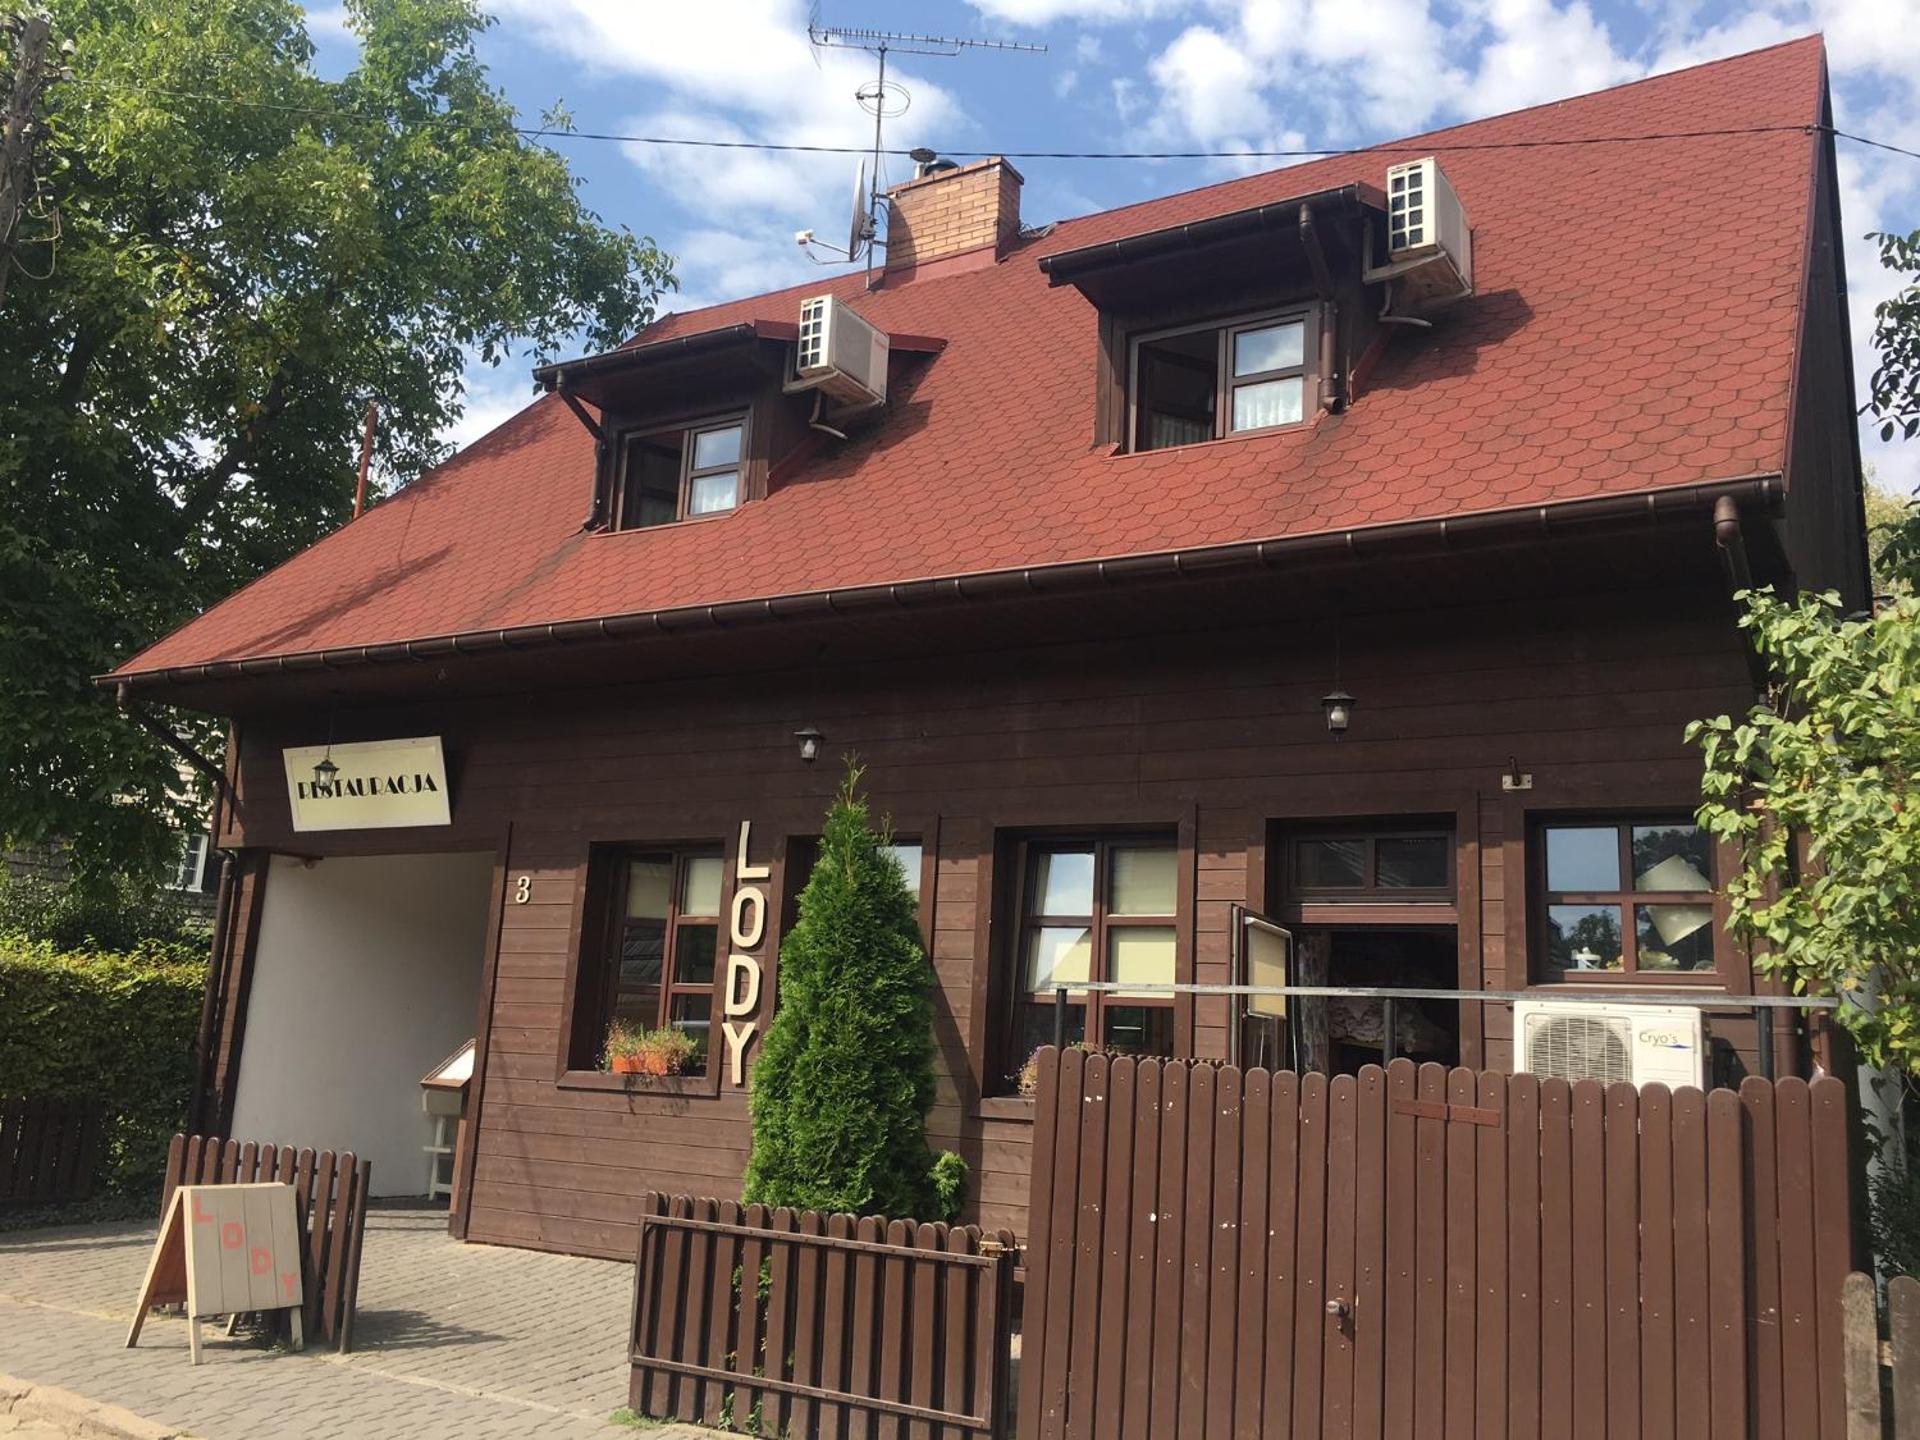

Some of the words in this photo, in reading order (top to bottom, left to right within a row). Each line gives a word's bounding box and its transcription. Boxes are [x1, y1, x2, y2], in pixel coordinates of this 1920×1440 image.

[516, 875, 530, 903] 3
[722, 821, 770, 1084] LODY
[1639, 1031, 1678, 1047] Cryo's
[193, 1195, 297, 1299] LODY
